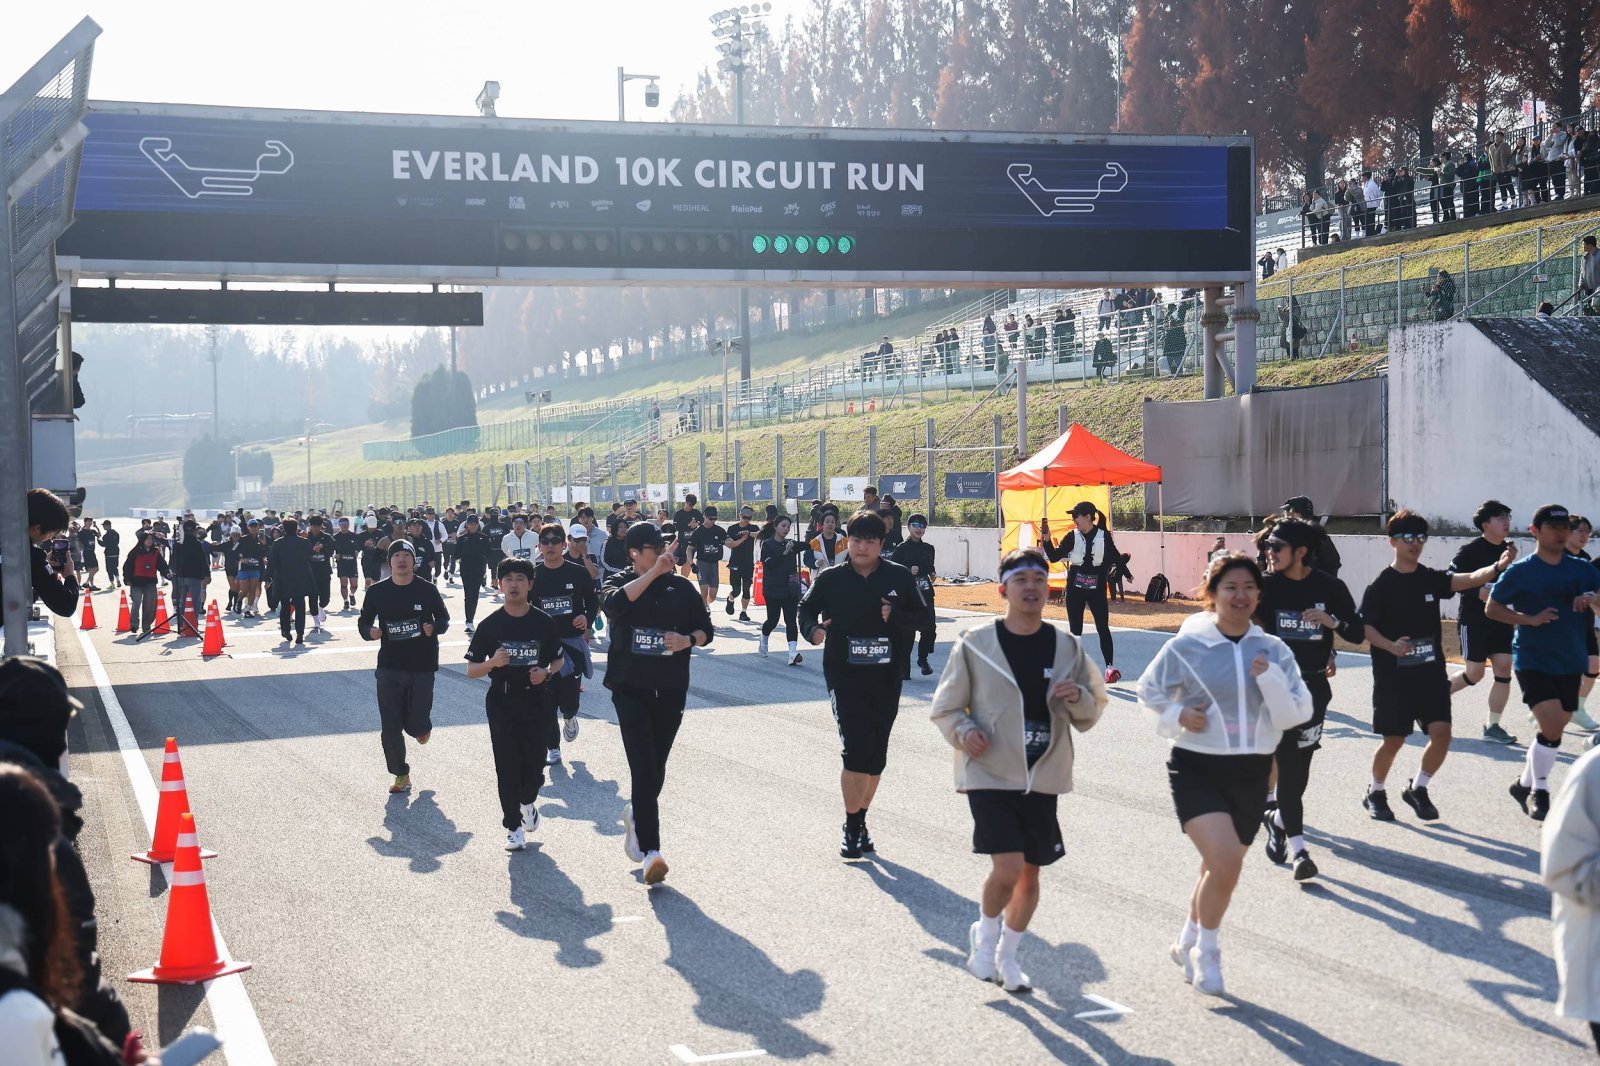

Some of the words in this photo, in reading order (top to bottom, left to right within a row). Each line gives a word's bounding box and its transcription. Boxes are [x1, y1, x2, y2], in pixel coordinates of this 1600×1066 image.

[392, 150, 599, 184] EVERLAND
[615, 157, 682, 187] 10K
[695, 159, 835, 189] CIRCUIT
[848, 162, 924, 191] RUN
[673, 204, 710, 212] MEDIHEAL
[1280, 619, 1297, 628] U55
[636, 635, 651, 644] U55
[518, 648, 537, 656] 1439
[852, 646, 867, 654] U55
[869, 645, 889, 654] 2667
